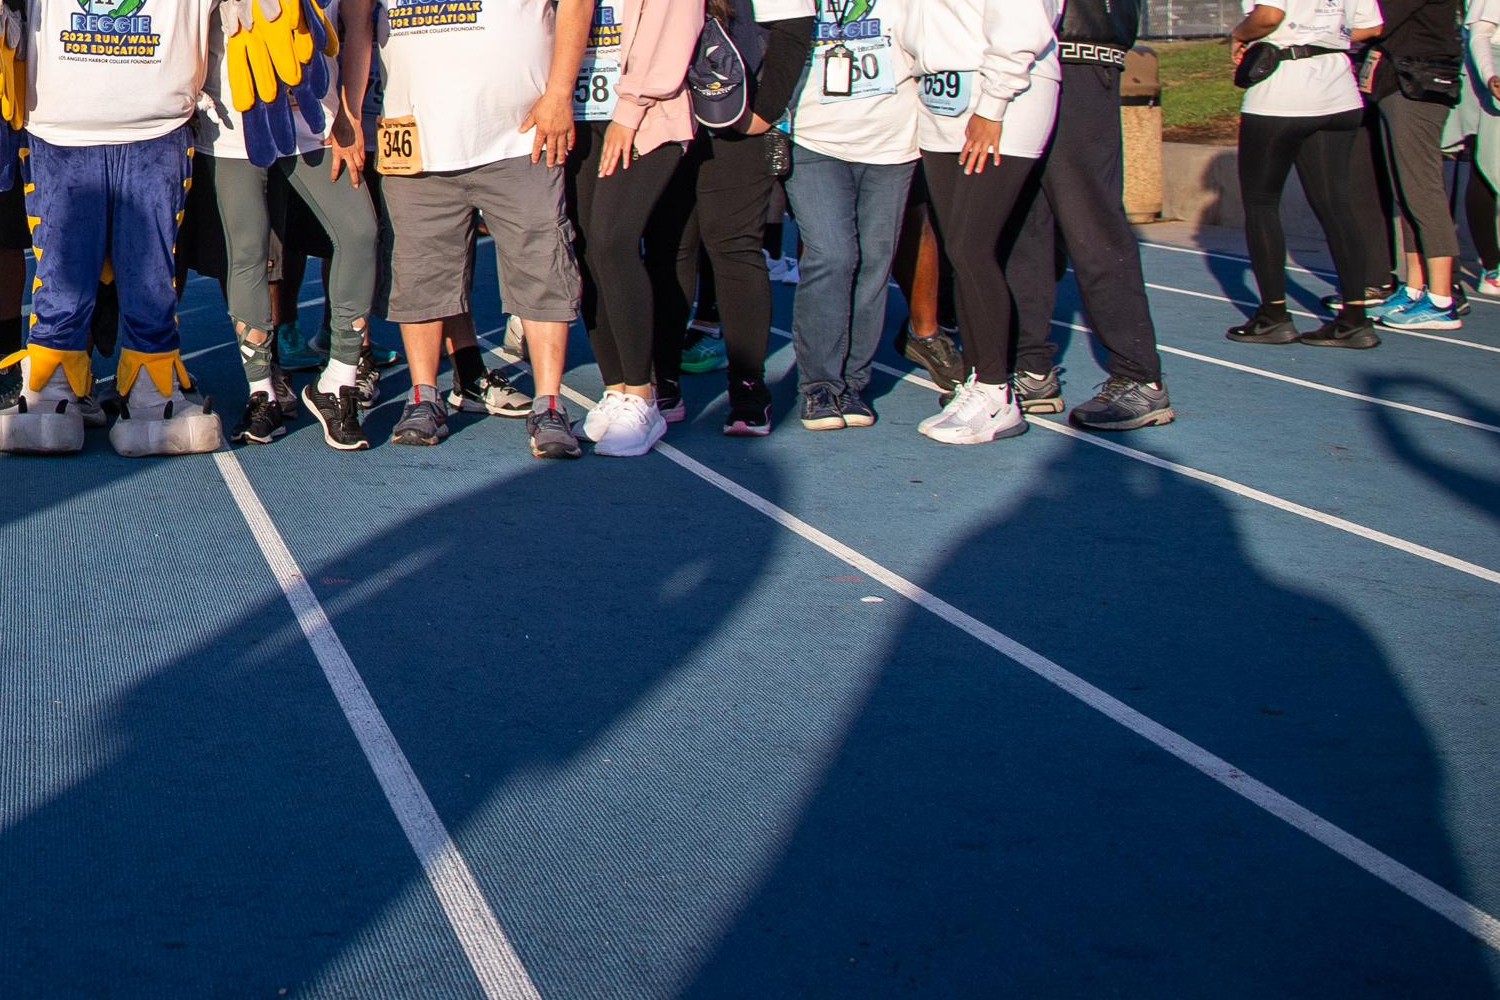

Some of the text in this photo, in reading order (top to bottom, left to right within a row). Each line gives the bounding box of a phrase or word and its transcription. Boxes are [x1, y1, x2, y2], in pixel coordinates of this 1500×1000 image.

[389, 2, 481, 18] 2022 RUN/WALK
[71, 13, 151, 34] REGGIE
[391, 12, 476, 28] FOR EDUCATION
[61, 31, 160, 46] 2022 RUN/WALK
[588, 35, 620, 47] ATION
[65, 43, 154, 56] FOR EDUCATION
[851, 53, 879, 83] 60
[574, 75, 609, 104] 58
[924, 71, 961, 98] 659
[383, 129, 412, 158] 346
